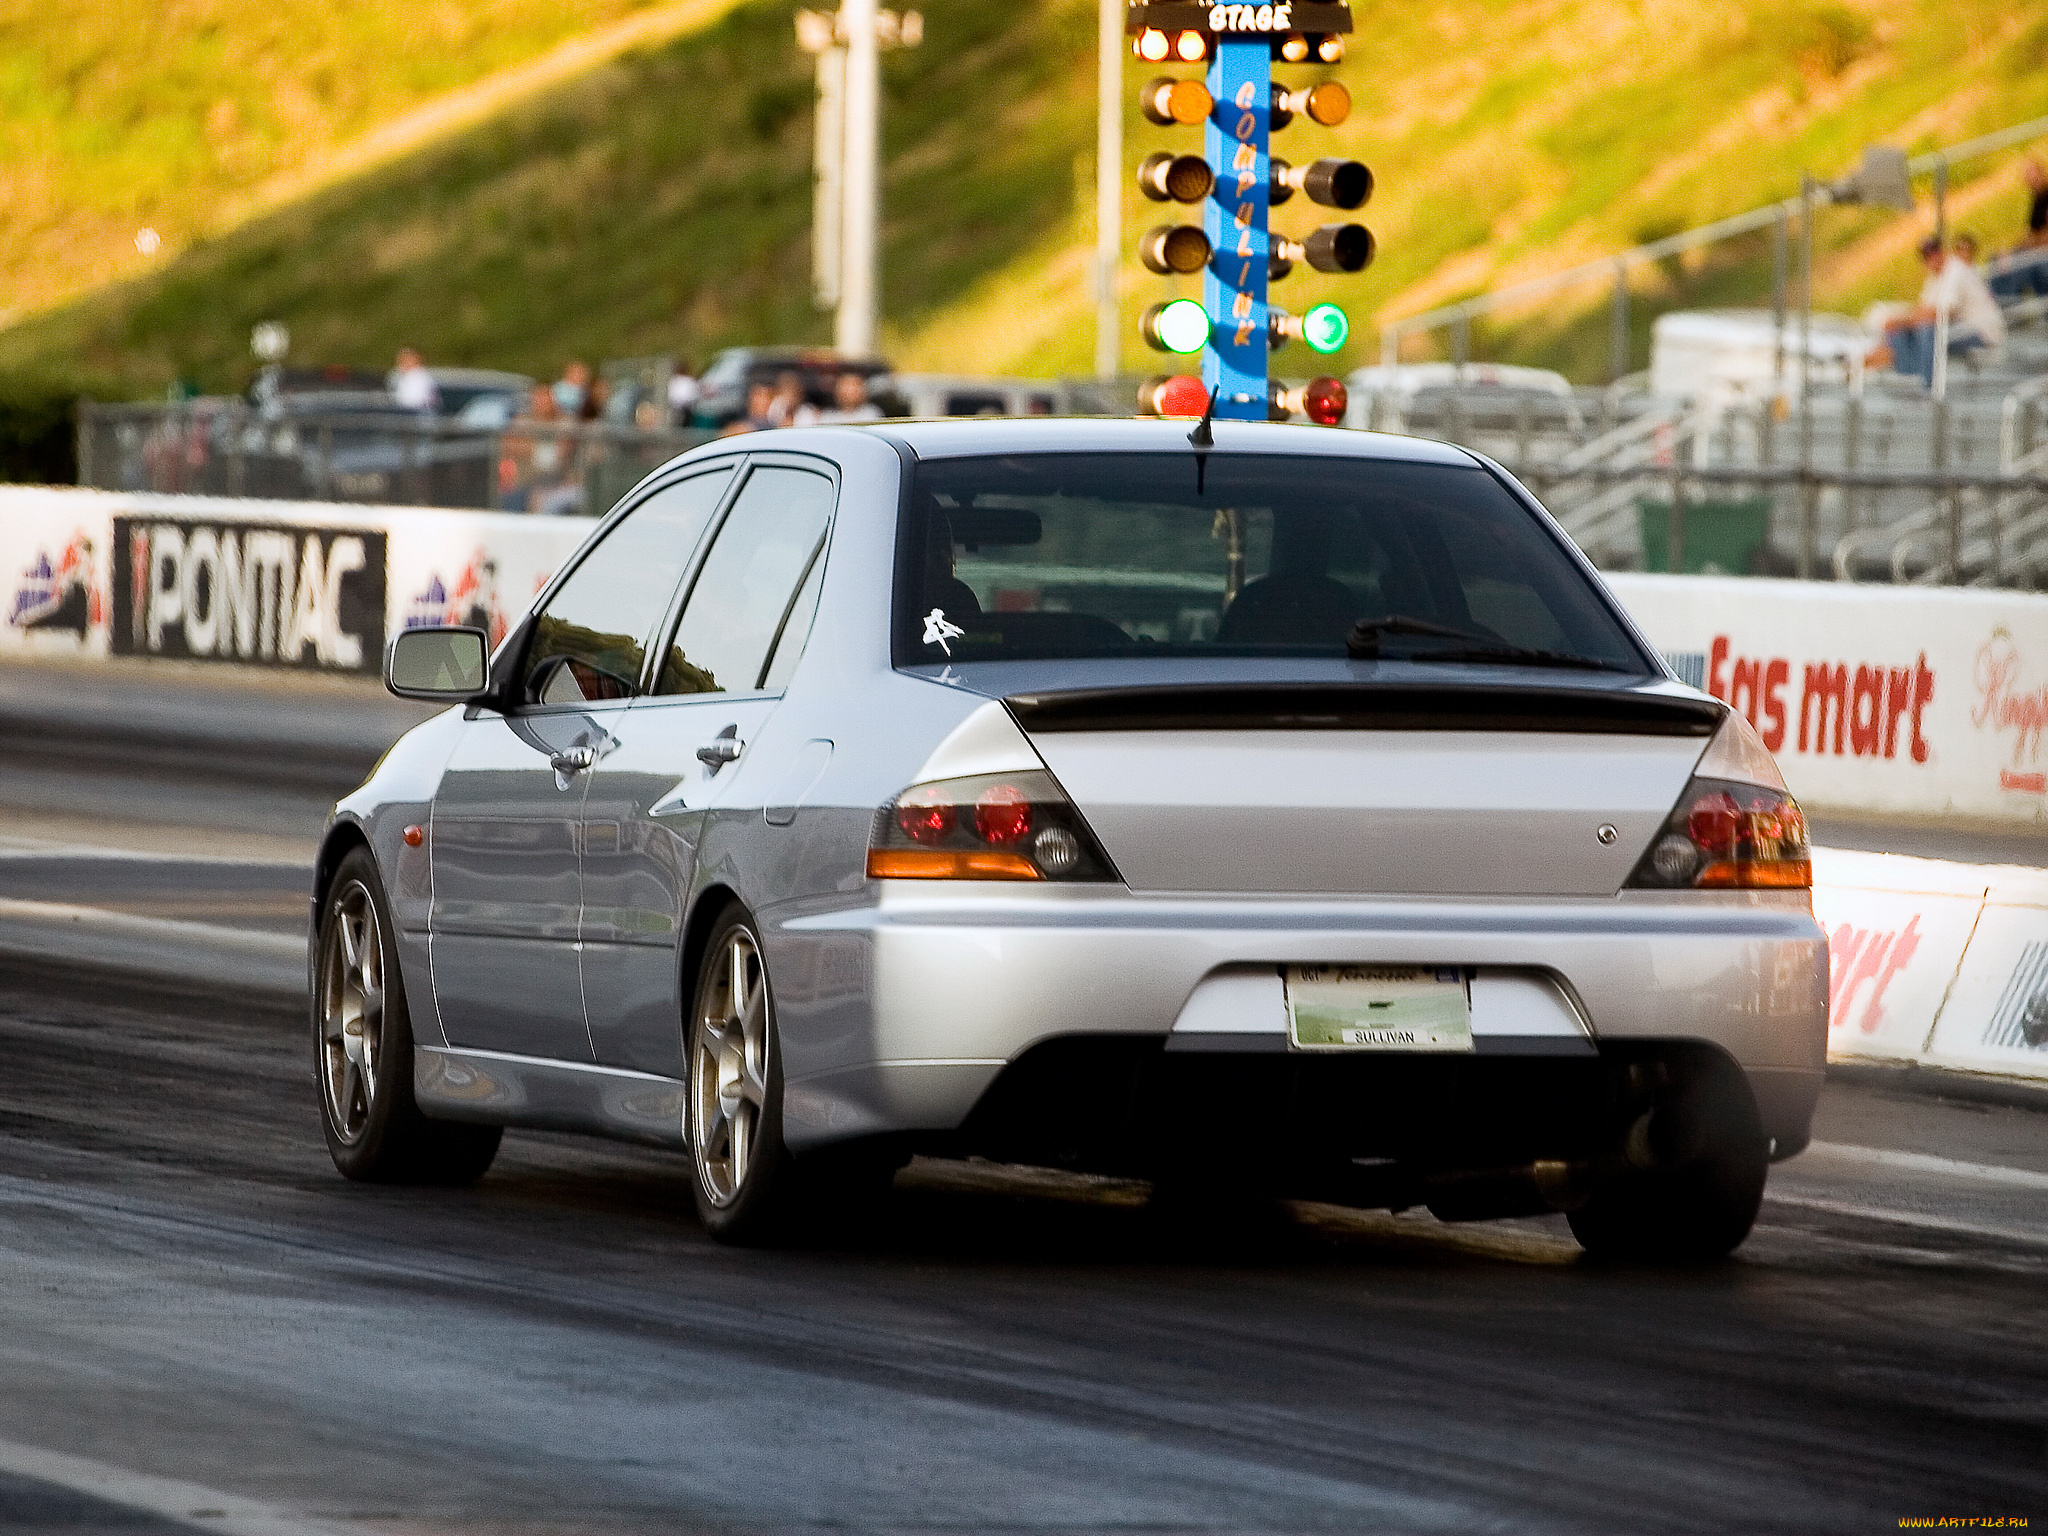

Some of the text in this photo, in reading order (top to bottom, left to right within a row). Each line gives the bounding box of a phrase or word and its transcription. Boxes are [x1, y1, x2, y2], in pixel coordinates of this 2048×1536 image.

[1208, 4, 1293, 32] STAGE
[148, 524, 367, 669] PONTIAC
[1797, 650, 1934, 764] mart
[1355, 1030, 1415, 1044] SULLIVAN
